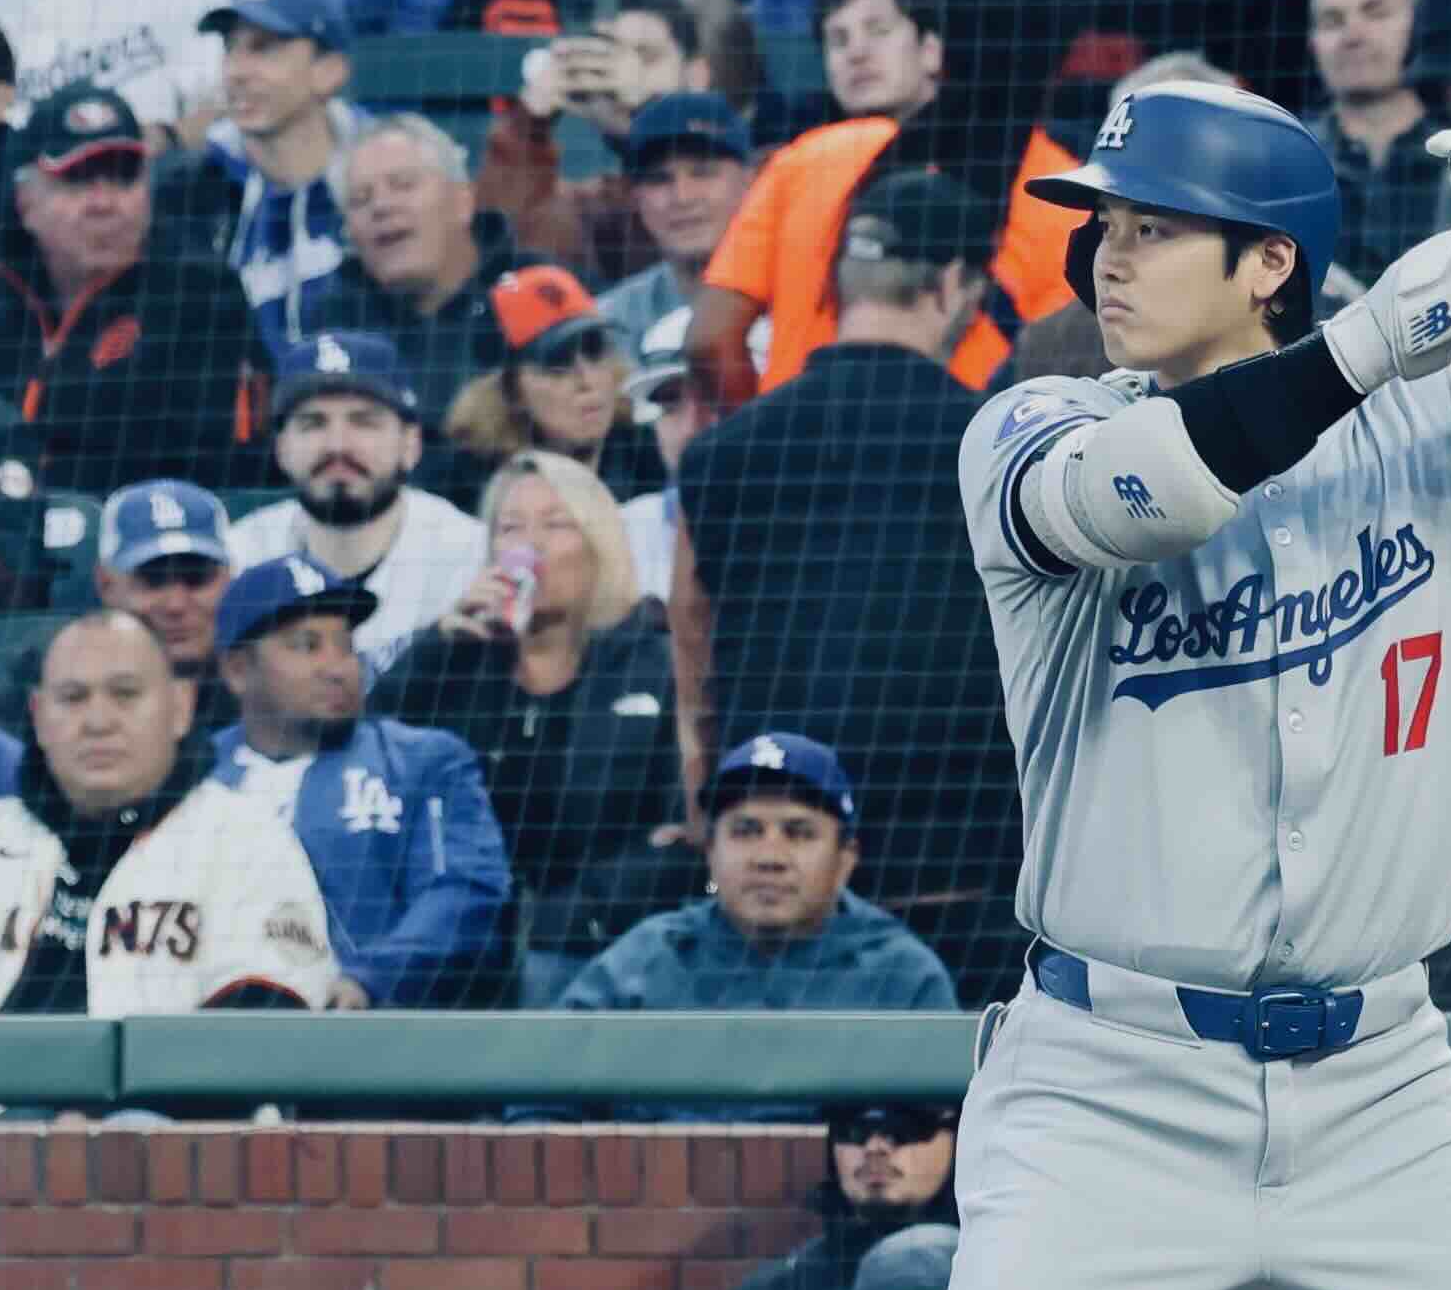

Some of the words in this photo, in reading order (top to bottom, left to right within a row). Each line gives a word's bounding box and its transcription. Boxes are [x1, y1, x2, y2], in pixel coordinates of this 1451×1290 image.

[1108, 580, 1208, 665] Los
[1203, 522, 1436, 687] Angeles
[1383, 634, 1441, 754] 17
[339, 765, 403, 835] LA
